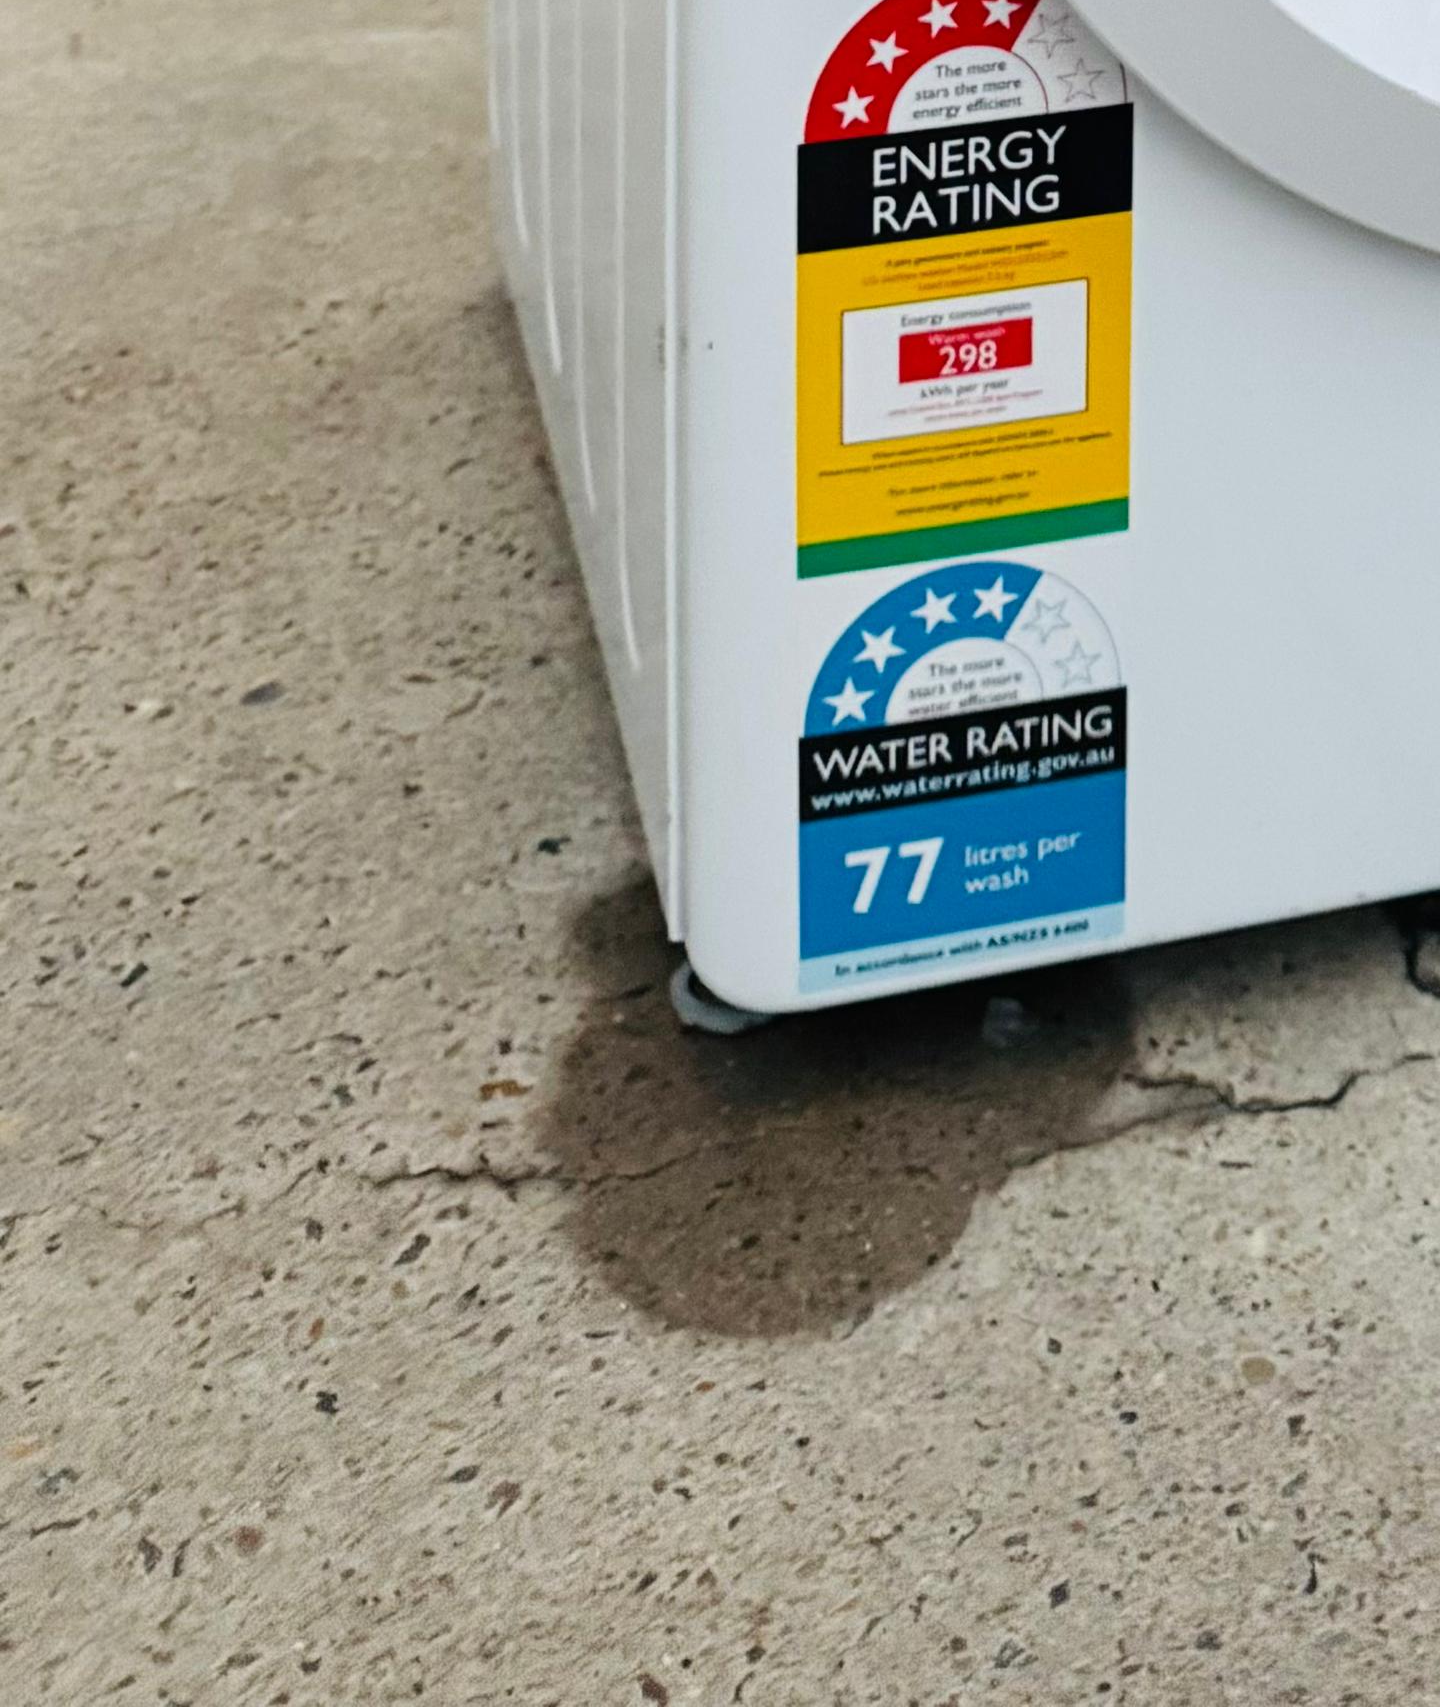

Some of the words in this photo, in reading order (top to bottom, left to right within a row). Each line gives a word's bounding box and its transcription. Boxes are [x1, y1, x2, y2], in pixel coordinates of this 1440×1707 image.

[936, 64, 962, 78] The
[966, 61, 1006, 75] more
[912, 105, 961, 119] energy
[966, 96, 1021, 112] efficient
[915, 87, 949, 101] stars
[954, 82, 977, 96] the
[982, 79, 1021, 92] more
[872, 125, 1066, 188] ENERGY
[872, 175, 1060, 236] RATING
[901, 313, 943, 327] Energy
[938, 339, 997, 375] 298
[930, 663, 957, 676] The
[812, 731, 951, 782] WATER
[966, 705, 1113, 760] RATING
[811, 746, 1115, 811] www.waterrating.gov.au
[964, 841, 1028, 868] litres
[1037, 831, 1082, 862] per
[845, 836, 944, 914] 77
[964, 865, 1030, 894] wash
